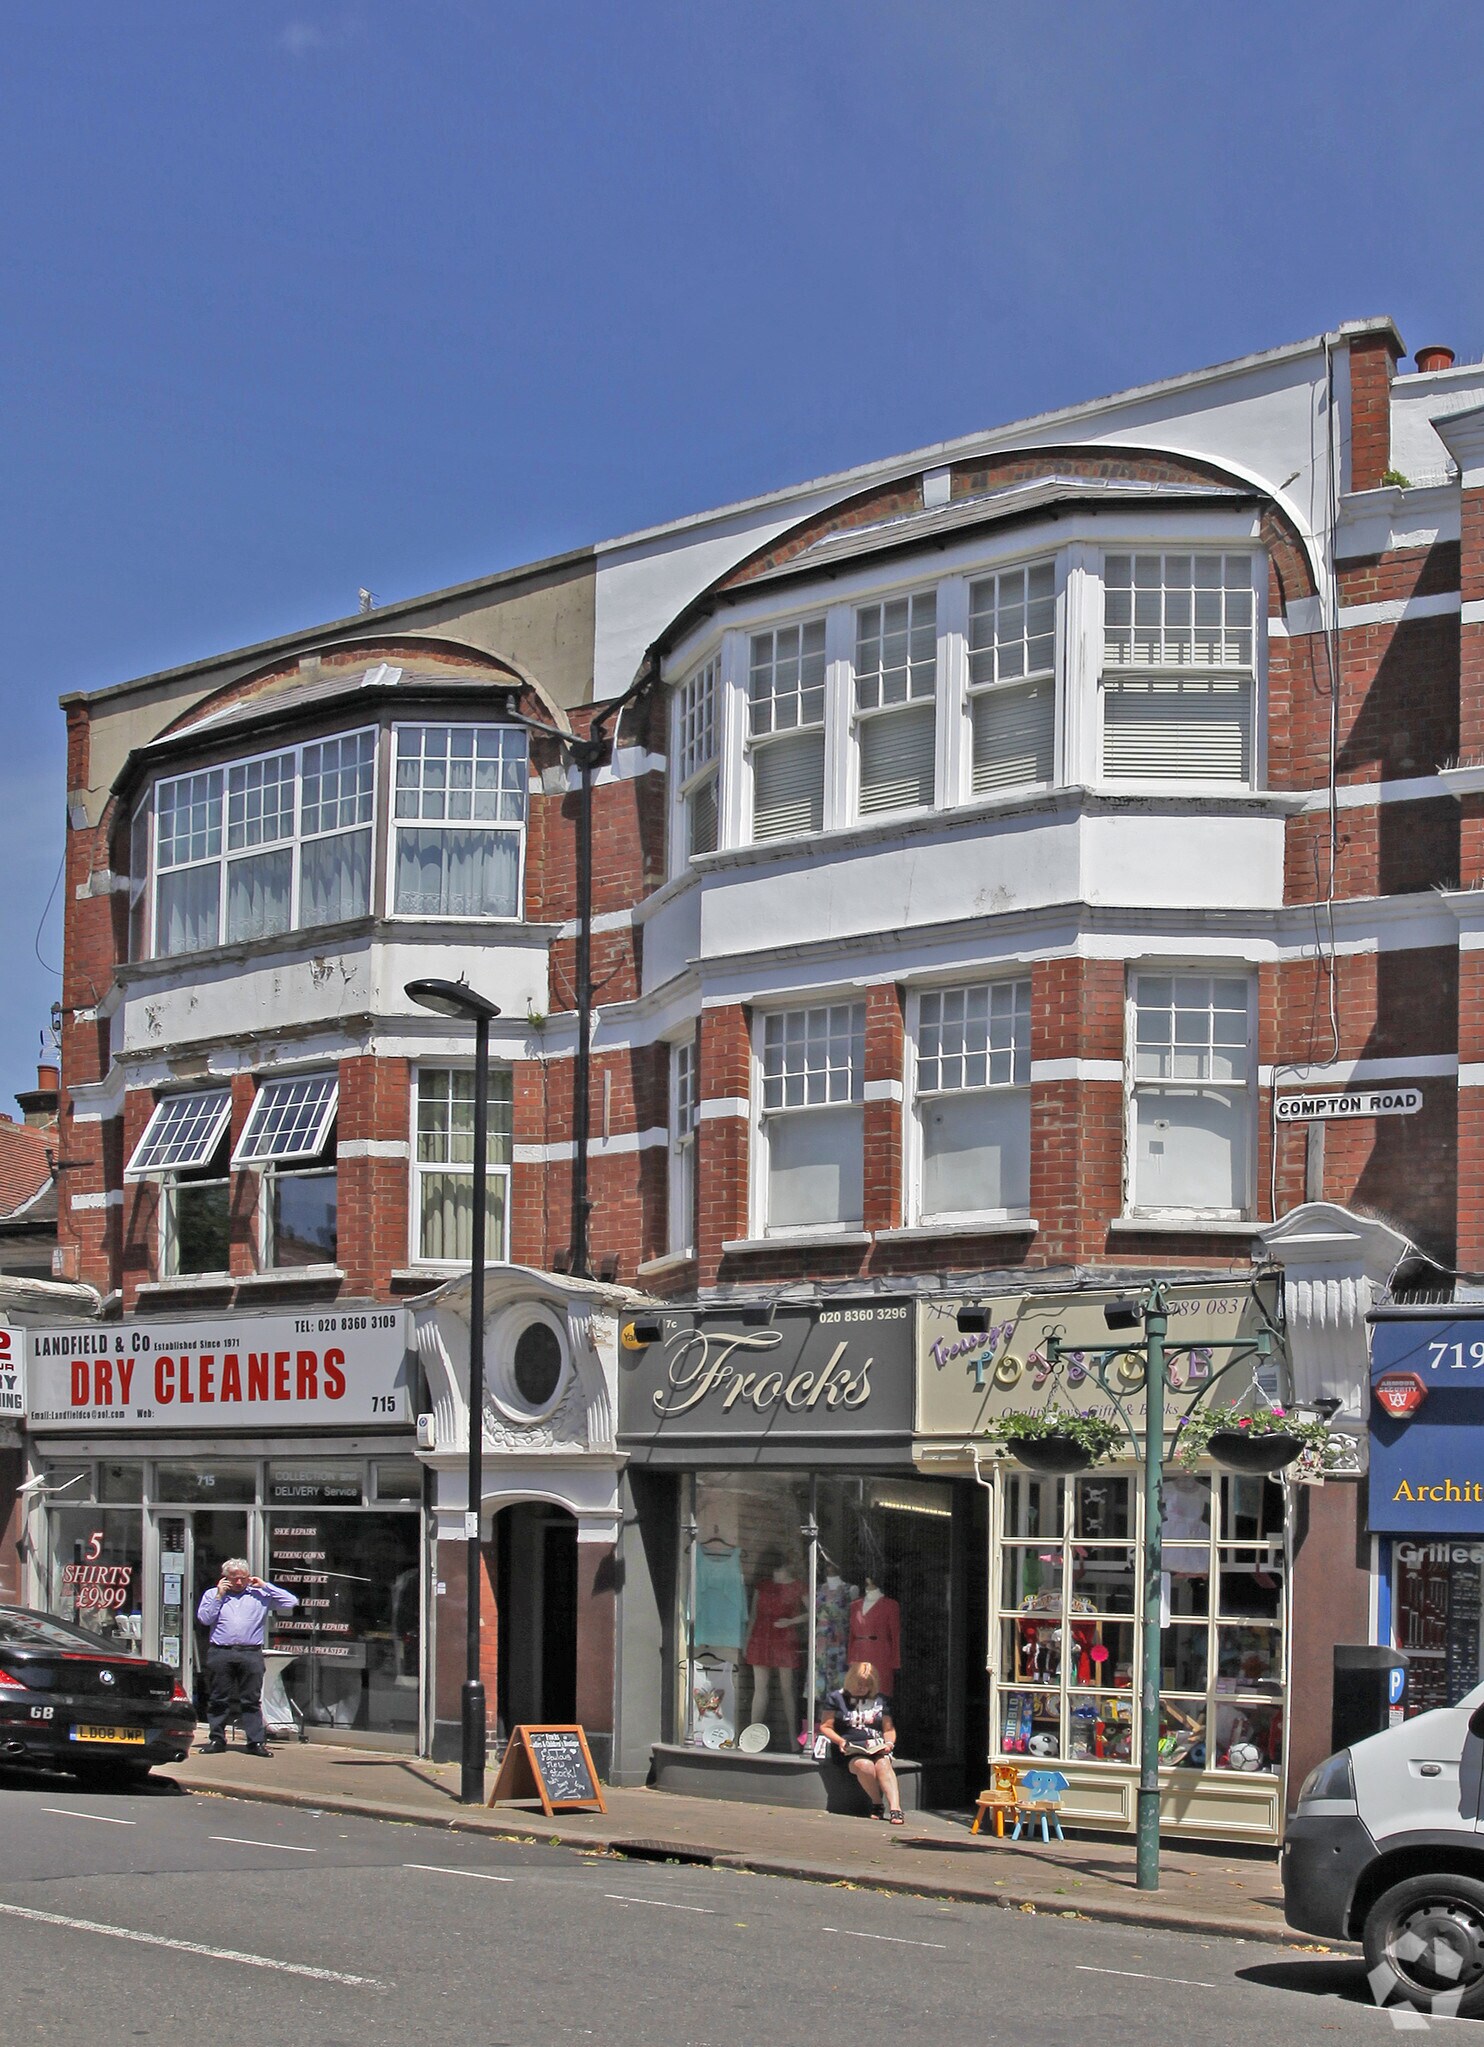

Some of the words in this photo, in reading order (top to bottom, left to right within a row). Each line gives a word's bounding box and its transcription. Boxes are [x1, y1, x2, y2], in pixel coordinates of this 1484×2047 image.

[1279, 1097, 1361, 1116] COMPTON
[1370, 1094, 1417, 1110] ROAD
[819, 1311, 841, 1324] 020
[844, 1309, 874, 1322] 8360
[876, 1307, 907, 1320] 3296
[295, 1320, 314, 1333] TEL:
[318, 1318, 337, 1332] 020
[341, 1316, 367, 1331] 8360
[371, 1314, 396, 1329] 3109
[35, 1334, 108, 1357] LANDFIELD
[115, 1336, 124, 1353] &
[154, 1340, 198, 1352] Established
[200, 1339, 221, 1349] Since
[224, 1338, 240, 1348] 1971
[1429, 1341, 1484, 1369] 719
[71, 1358, 135, 1407] DRY
[154, 1347, 346, 1405] CLEANERS
[653, 1328, 874, 1412] Frocks
[371, 1395, 396, 1413] 715
[1124, 1404, 1134, 1416] &
[1139, 1402, 1179, 1416] Bks
[137, 1409, 155, 1418] Web:
[275, 1471, 336, 1481] COLLECTION
[275, 1486, 320, 1496] DELIVERY
[324, 1486, 357, 1497] Service
[273, 1527, 290, 1536] SHOE
[290, 1528, 317, 1536] REPAIRS
[85, 1531, 104, 1561] 5
[273, 1551, 301, 1560] WEDDING
[303, 1551, 326, 1560] GOWNS
[62, 1564, 133, 1586] SHIRTS
[274, 1574, 302, 1583] LAUNDRY
[302, 1575, 329, 1584] SERVICE
[76, 1586, 127, 1609] £9.99
[301, 1598, 330, 1607] LEATHER
[274, 1621, 314, 1631] ALTERATIONS
[314, 1622, 320, 1631] &
[321, 1622, 349, 1632] REPAIRS
[304, 1645, 309, 1654] &
[310, 1646, 349, 1656] UPHOLSTERY
[30, 1706, 54, 1720] GB
[79, 1726, 117, 1740] LD08
[119, 1728, 143, 1741] JWP
